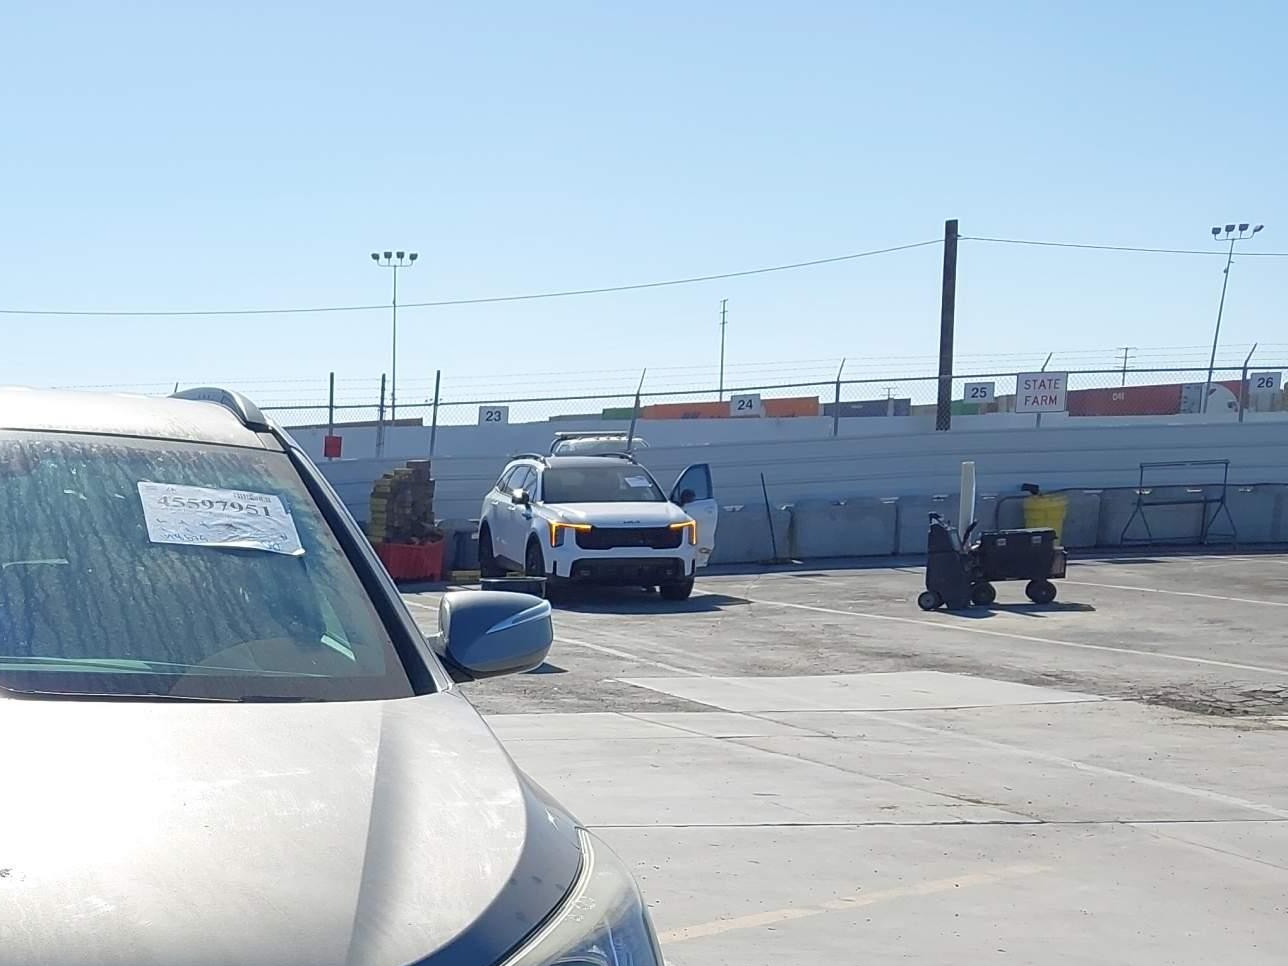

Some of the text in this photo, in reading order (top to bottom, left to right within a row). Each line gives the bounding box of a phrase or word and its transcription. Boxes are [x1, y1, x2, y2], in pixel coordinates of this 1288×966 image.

[1023, 378, 1061, 391] STATE
[1256, 376, 1274, 389] 26
[970, 386, 987, 399] 25
[737, 399, 753, 411] 24
[1024, 394, 1058, 407] FARM
[485, 410, 502, 422] 23
[157, 495, 273, 518] 45597951
